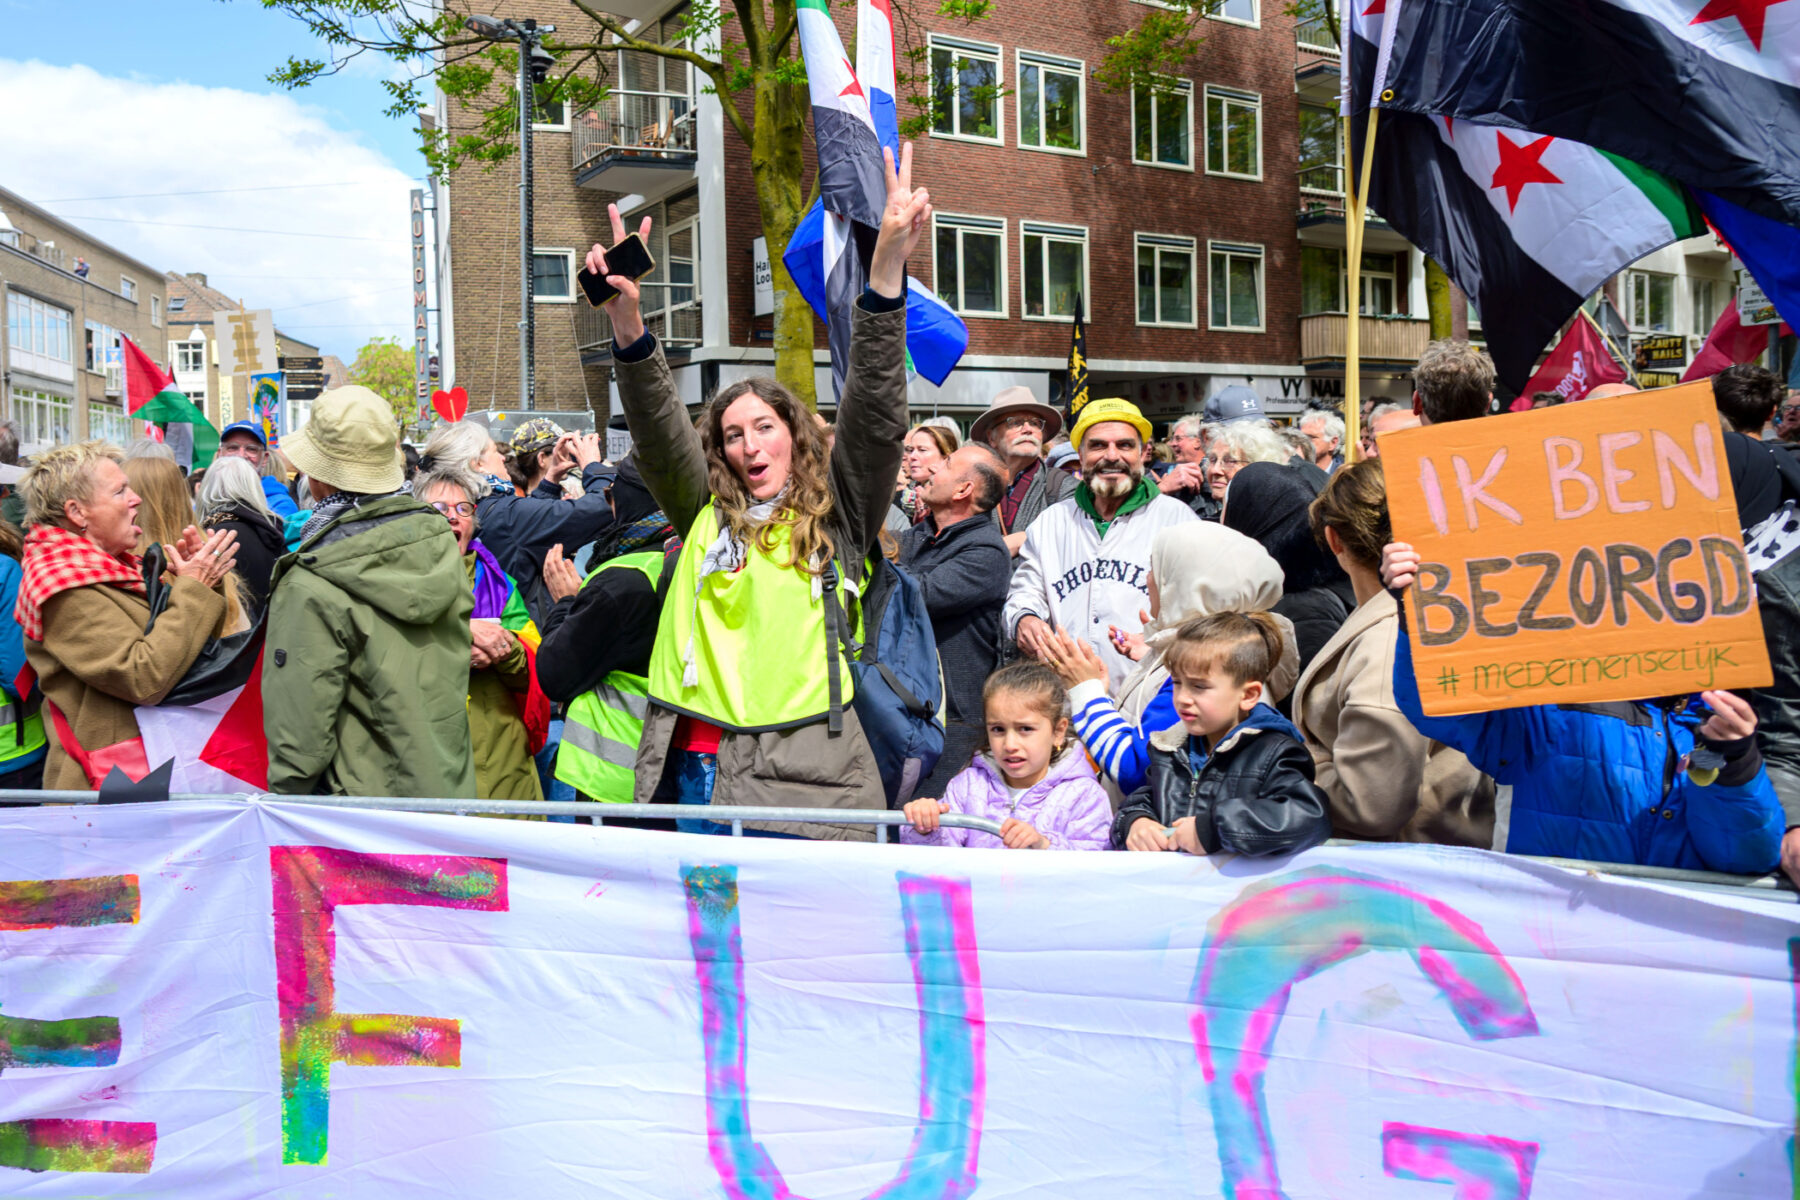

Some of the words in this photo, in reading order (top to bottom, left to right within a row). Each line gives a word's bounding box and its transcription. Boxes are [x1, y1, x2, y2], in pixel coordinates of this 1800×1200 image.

[412, 196, 430, 421] AUTOMATIEK
[1652, 348, 1683, 359] NAILS
[1281, 378, 1303, 397] VY
[1418, 446, 1524, 535] IK
[1542, 421, 1721, 521] BEN
[1410, 534, 1755, 648] BEZORGD
